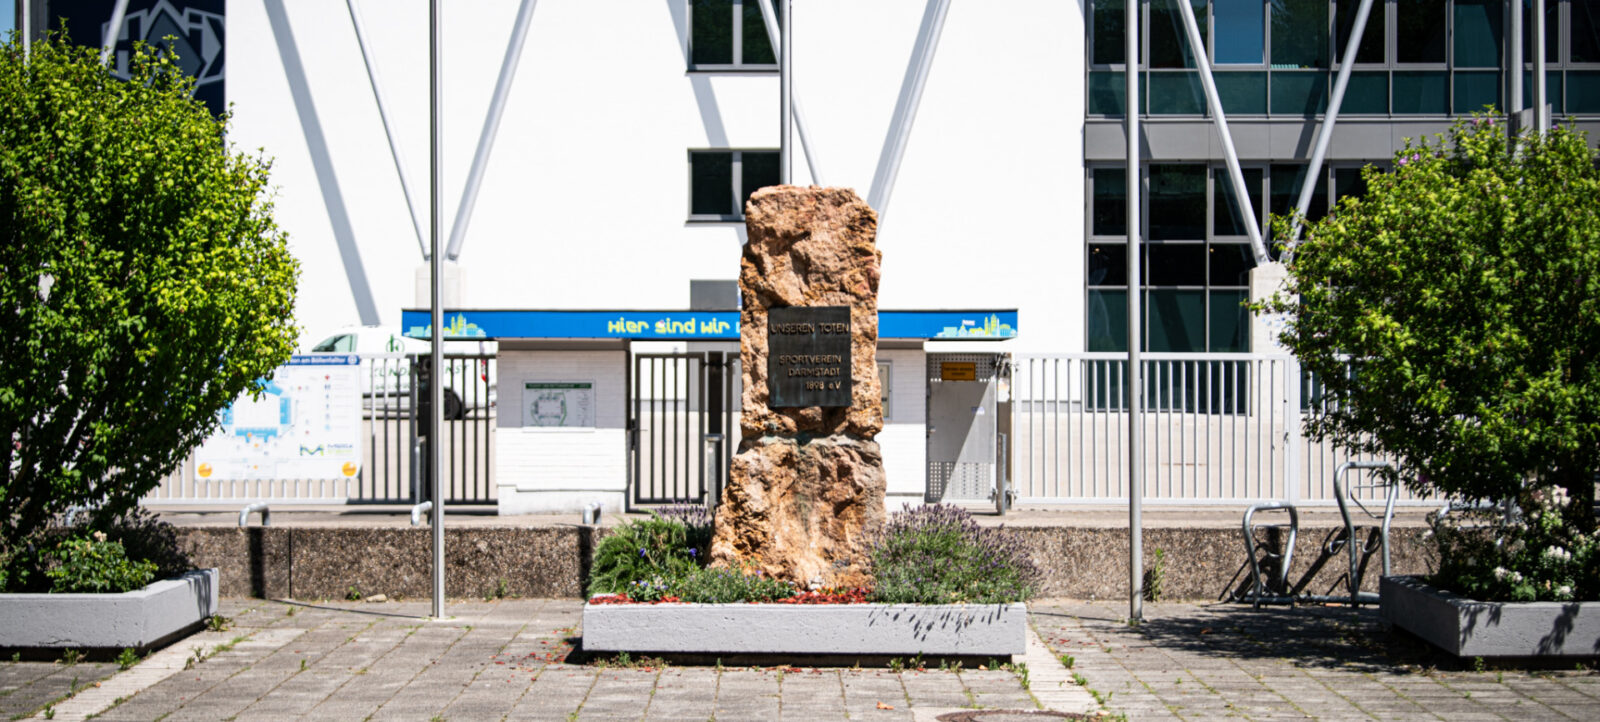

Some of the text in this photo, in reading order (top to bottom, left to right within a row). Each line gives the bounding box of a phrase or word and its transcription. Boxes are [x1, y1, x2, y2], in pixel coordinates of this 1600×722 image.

[608, 317, 650, 333] Hier
[655, 317, 696, 334] sind
[770, 322, 849, 334] UNSEREN TOTEN
[779, 354, 842, 365] SPORTVEREIN
[788, 367, 840, 377] DARMSTADT
[806, 381, 825, 391] 1898
